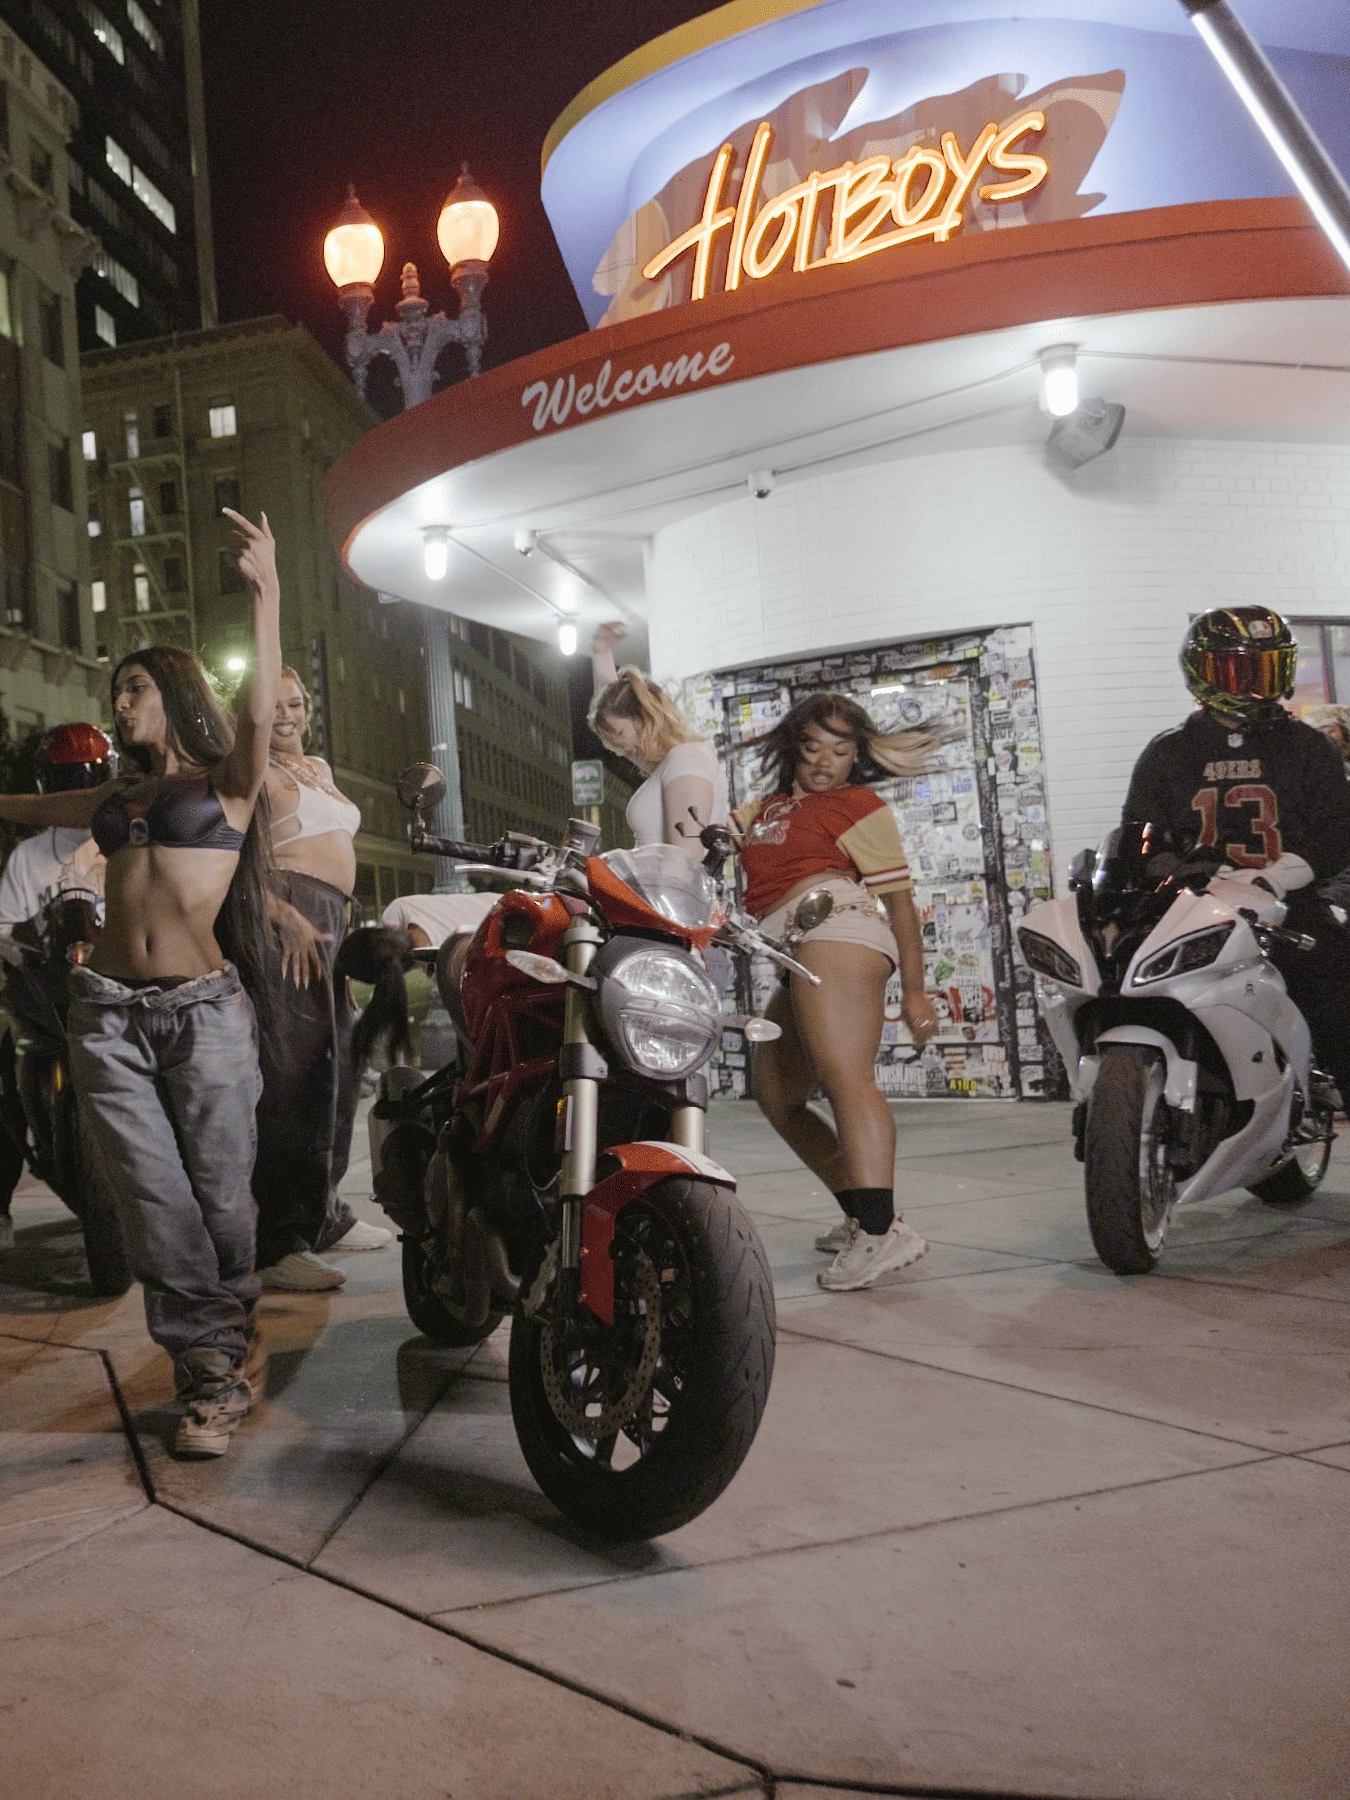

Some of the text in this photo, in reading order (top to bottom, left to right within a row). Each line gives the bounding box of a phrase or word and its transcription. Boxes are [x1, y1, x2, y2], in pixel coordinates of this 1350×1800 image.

[522, 340, 735, 430] Welcome
[1203, 759, 1261, 781] 49ERS
[1191, 784, 1282, 870] 13
